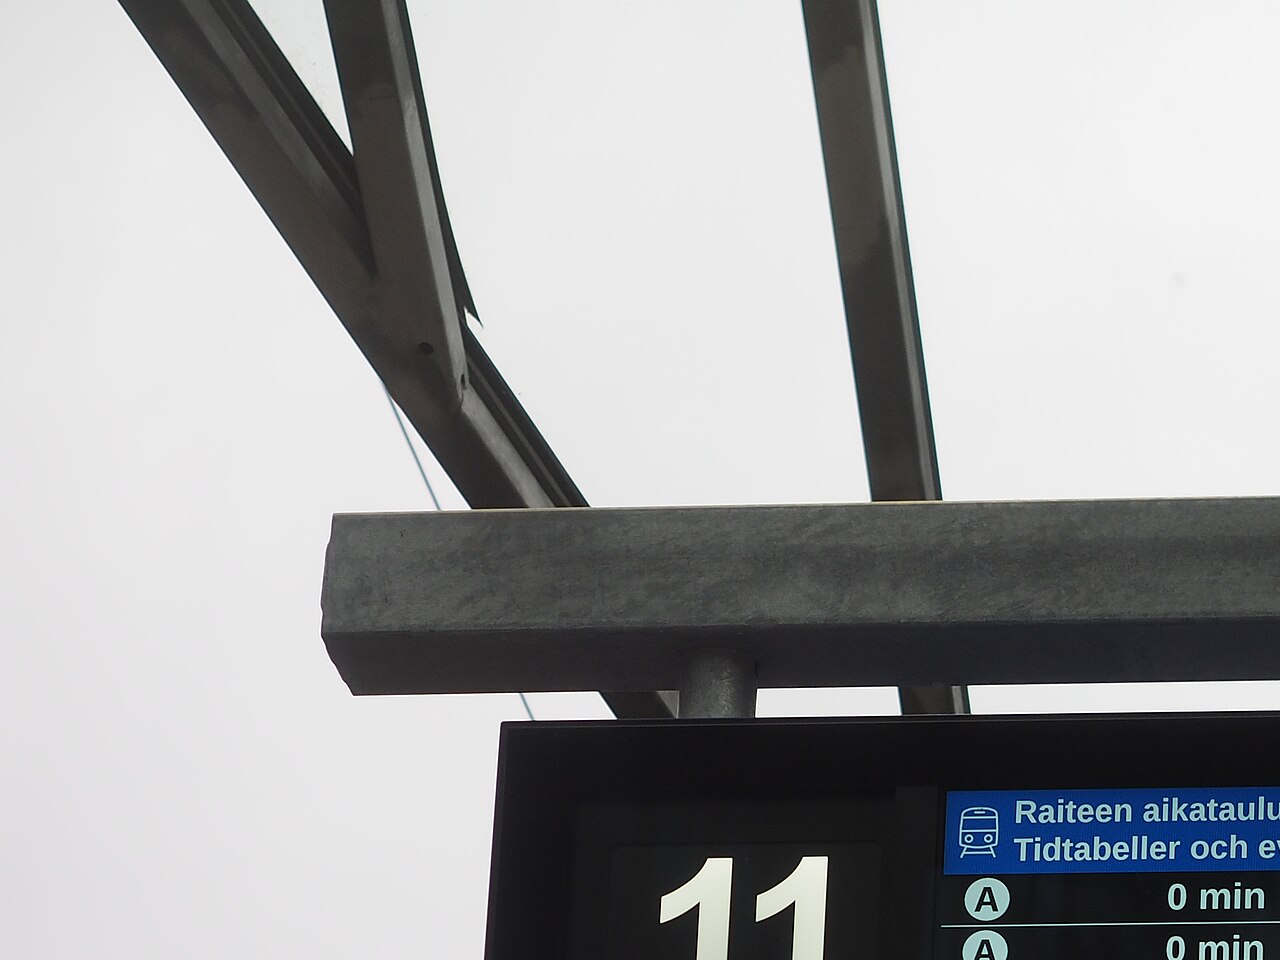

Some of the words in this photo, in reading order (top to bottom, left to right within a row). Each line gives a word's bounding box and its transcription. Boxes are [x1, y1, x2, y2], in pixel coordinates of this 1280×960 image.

[1016, 799, 1131, 823] Raiteen
[1014, 836, 1180, 861] Tidtabeller
[1191, 835, 1247, 859] och
[974, 885, 999, 912] A
[1168, 884, 1186, 910] 0
[1200, 882, 1264, 909] min
